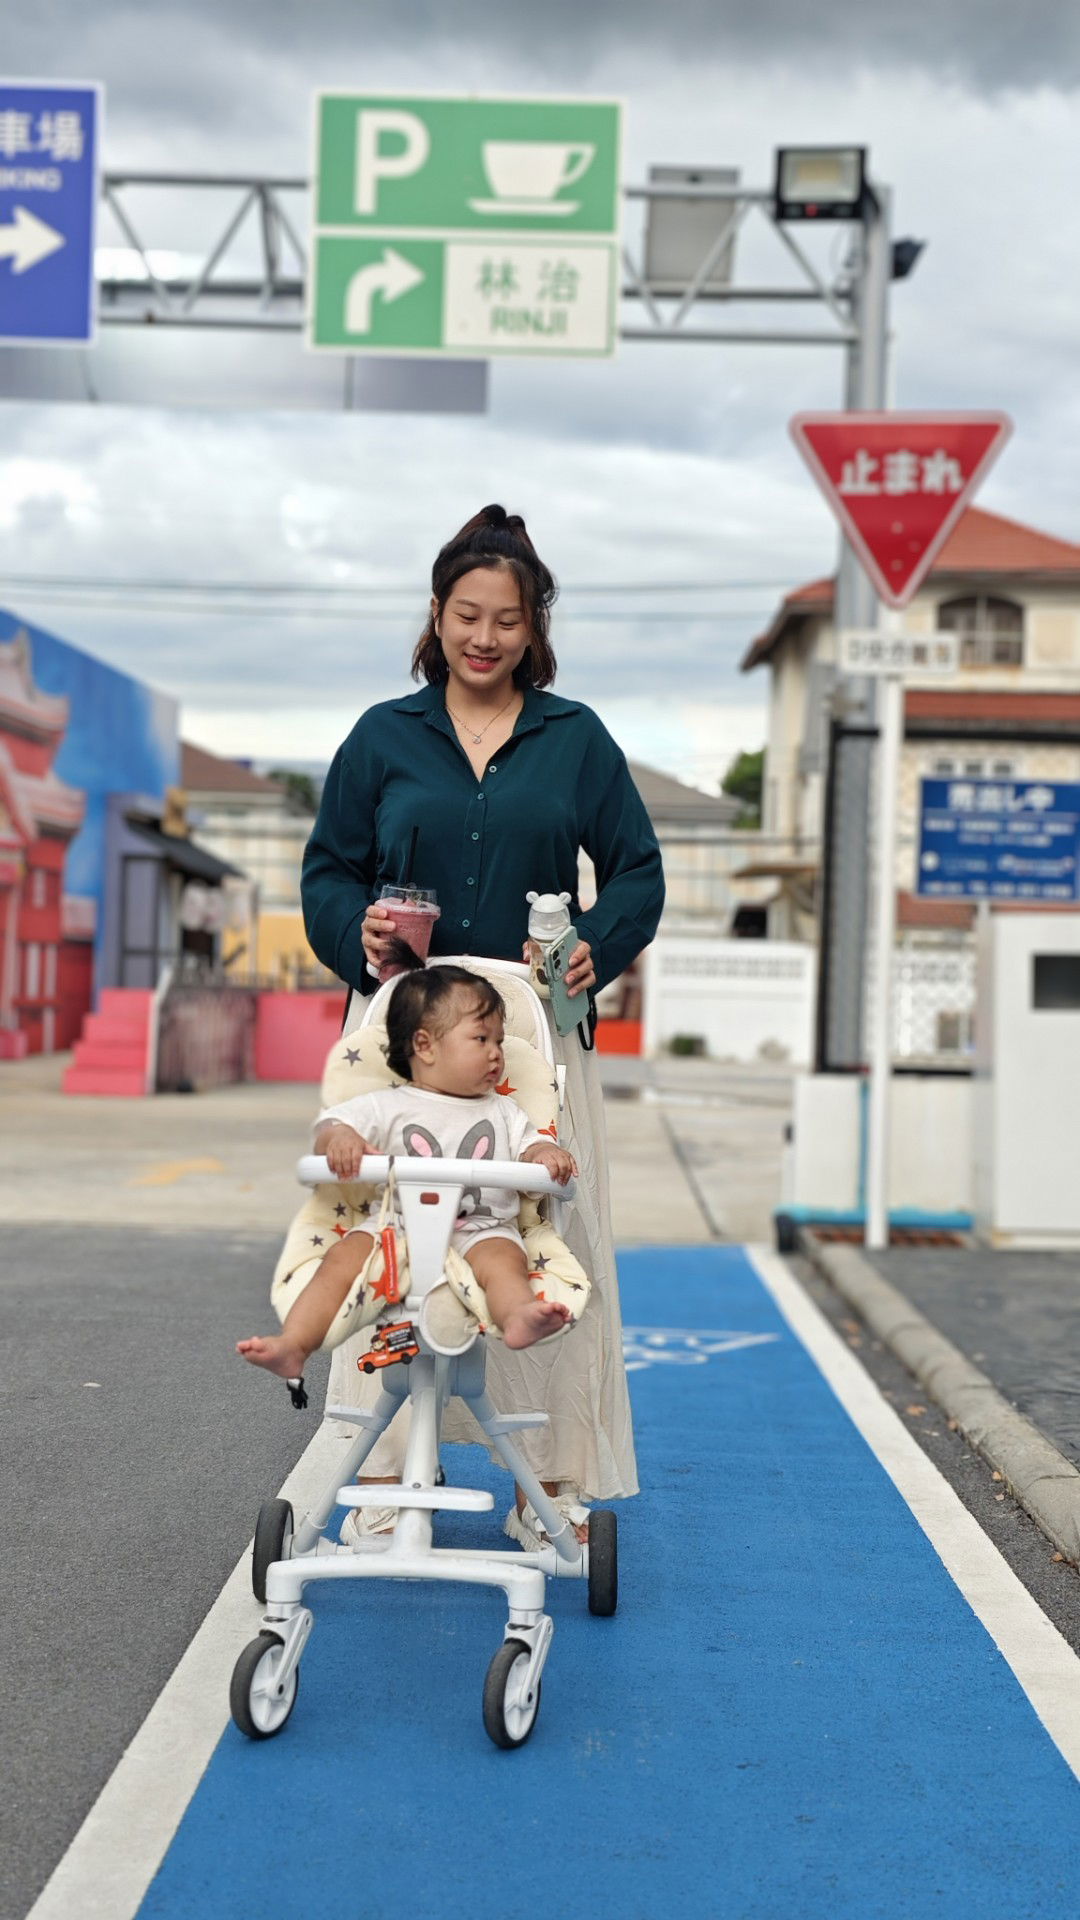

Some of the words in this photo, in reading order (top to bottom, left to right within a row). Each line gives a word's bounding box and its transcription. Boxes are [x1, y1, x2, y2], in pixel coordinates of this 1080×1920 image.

[354, 108, 430, 214] P
[490, 306, 568, 336] RINJI
[838, 448, 965, 495] 止まれ
